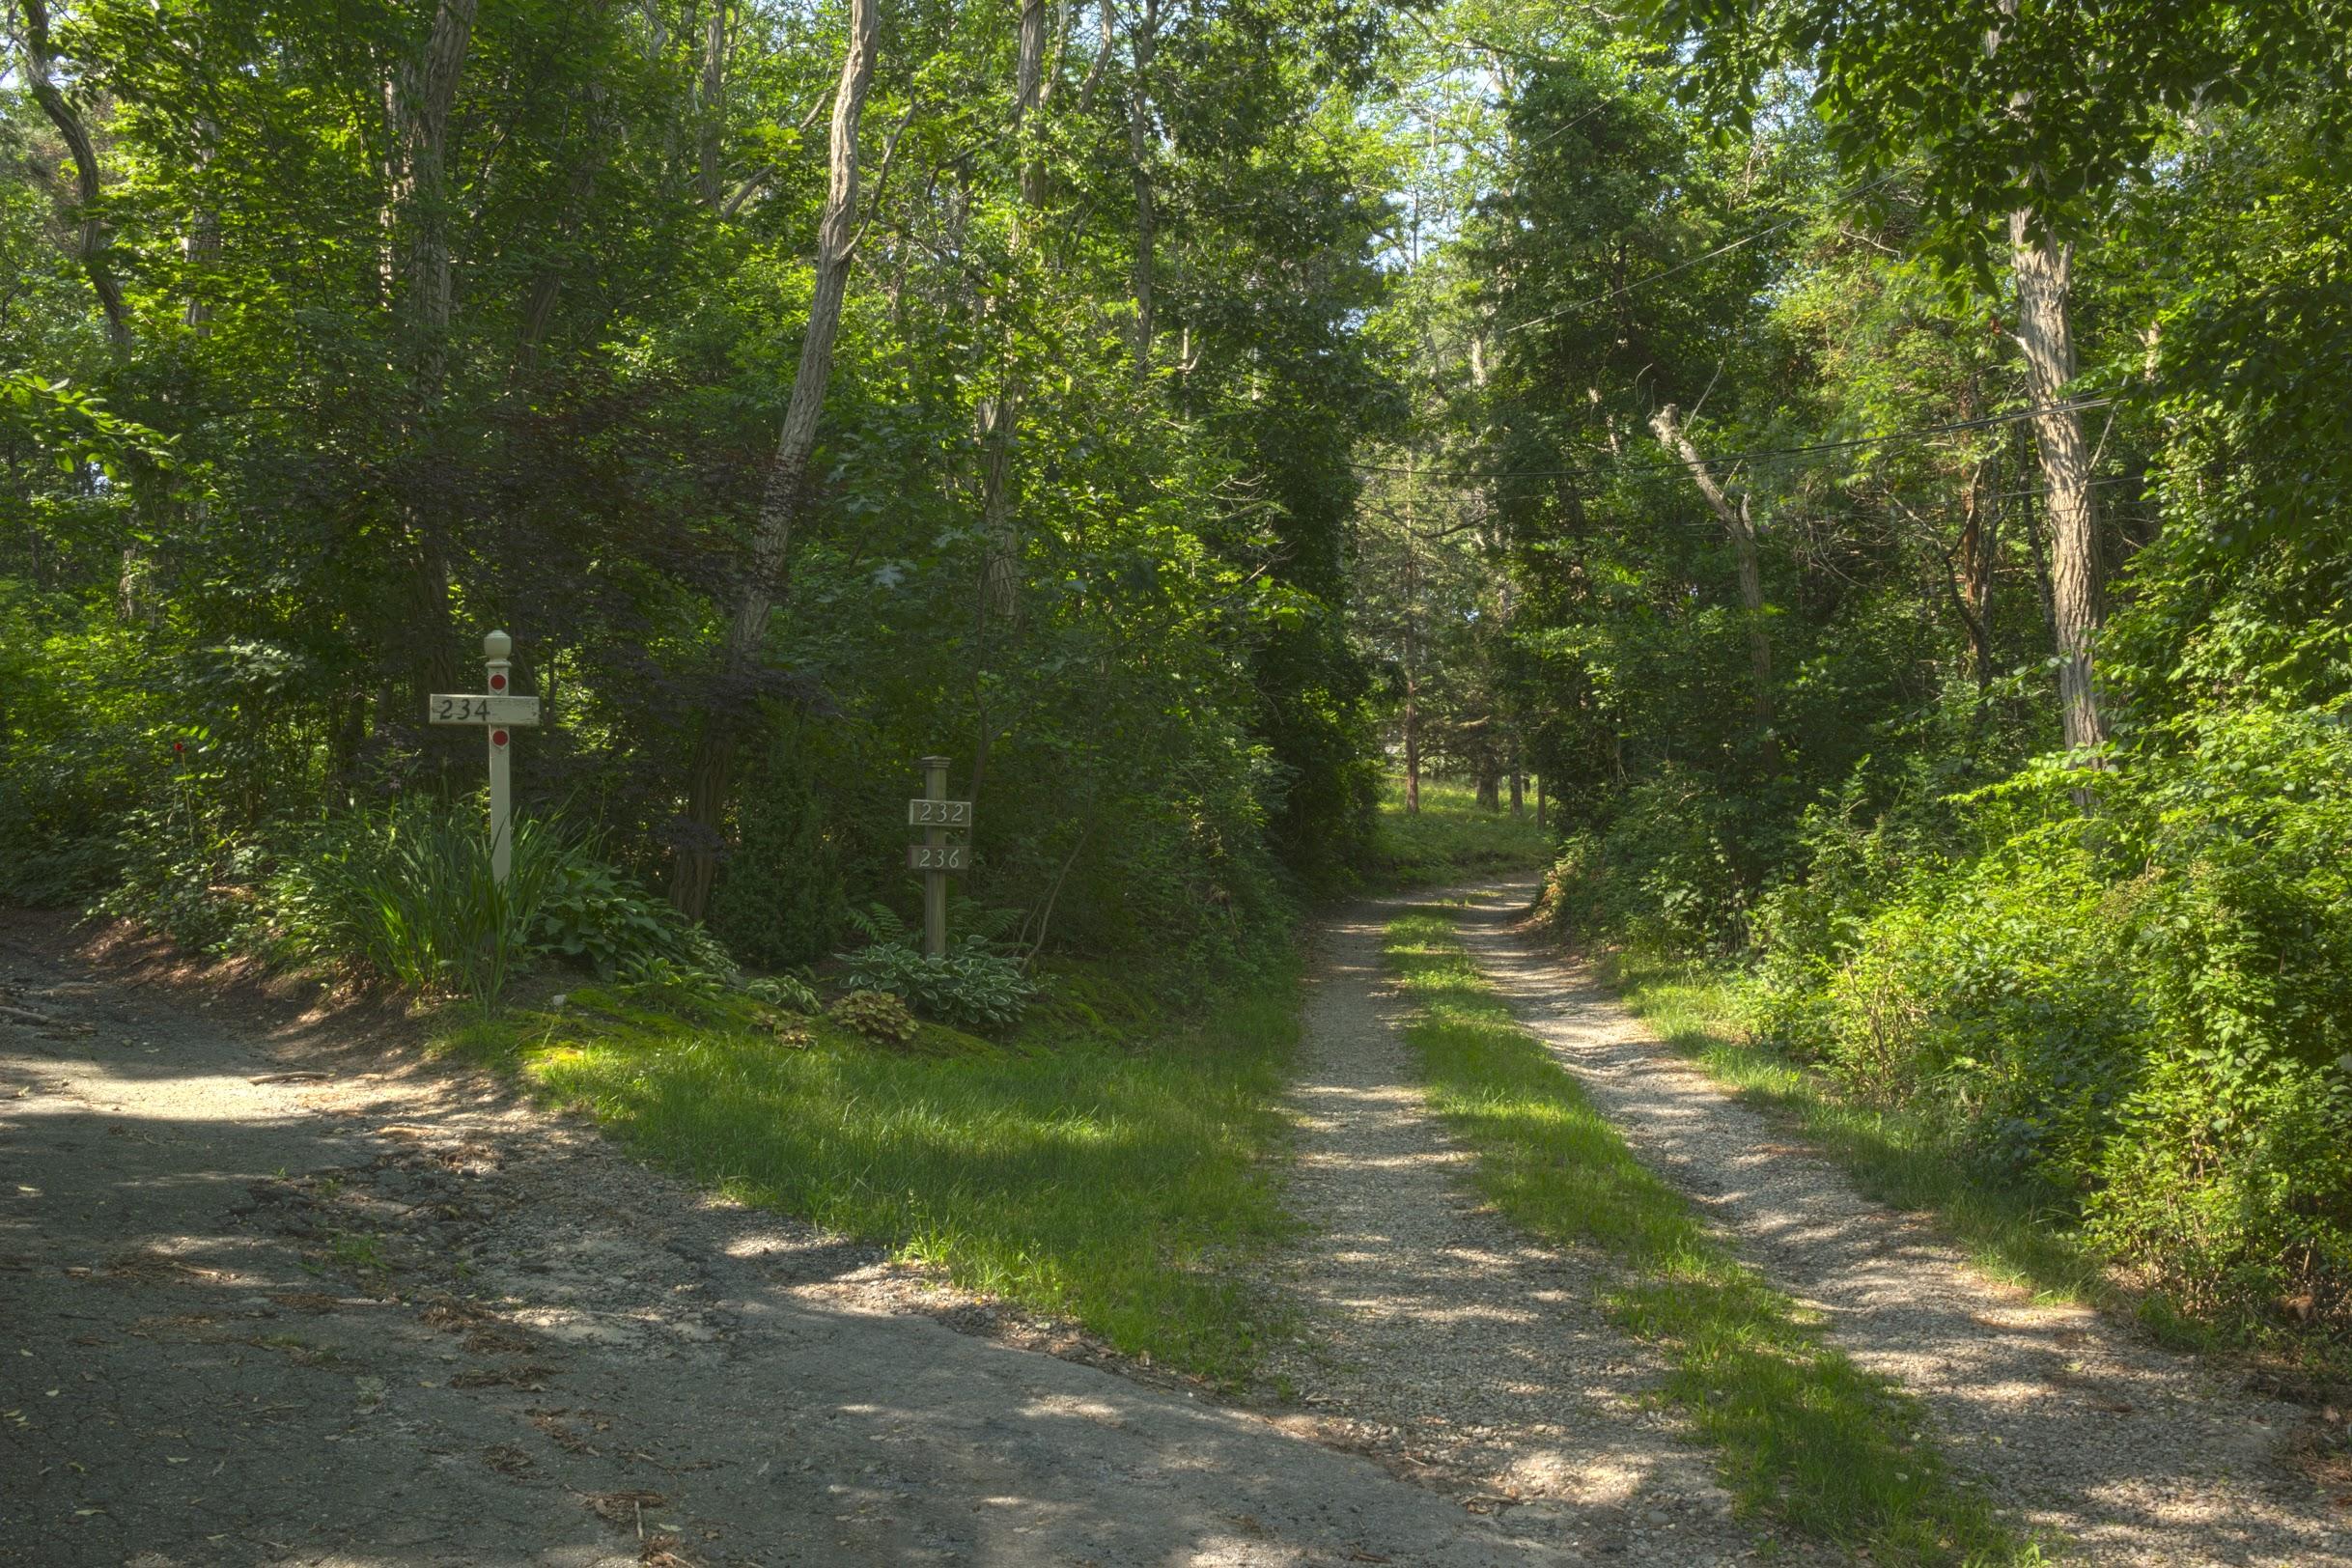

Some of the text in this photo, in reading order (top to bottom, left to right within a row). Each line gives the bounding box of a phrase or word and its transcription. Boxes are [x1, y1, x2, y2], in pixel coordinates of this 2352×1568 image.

[439, 698, 490, 721] 234
[920, 802, 964, 823] 232
[918, 849, 960, 868] 236
